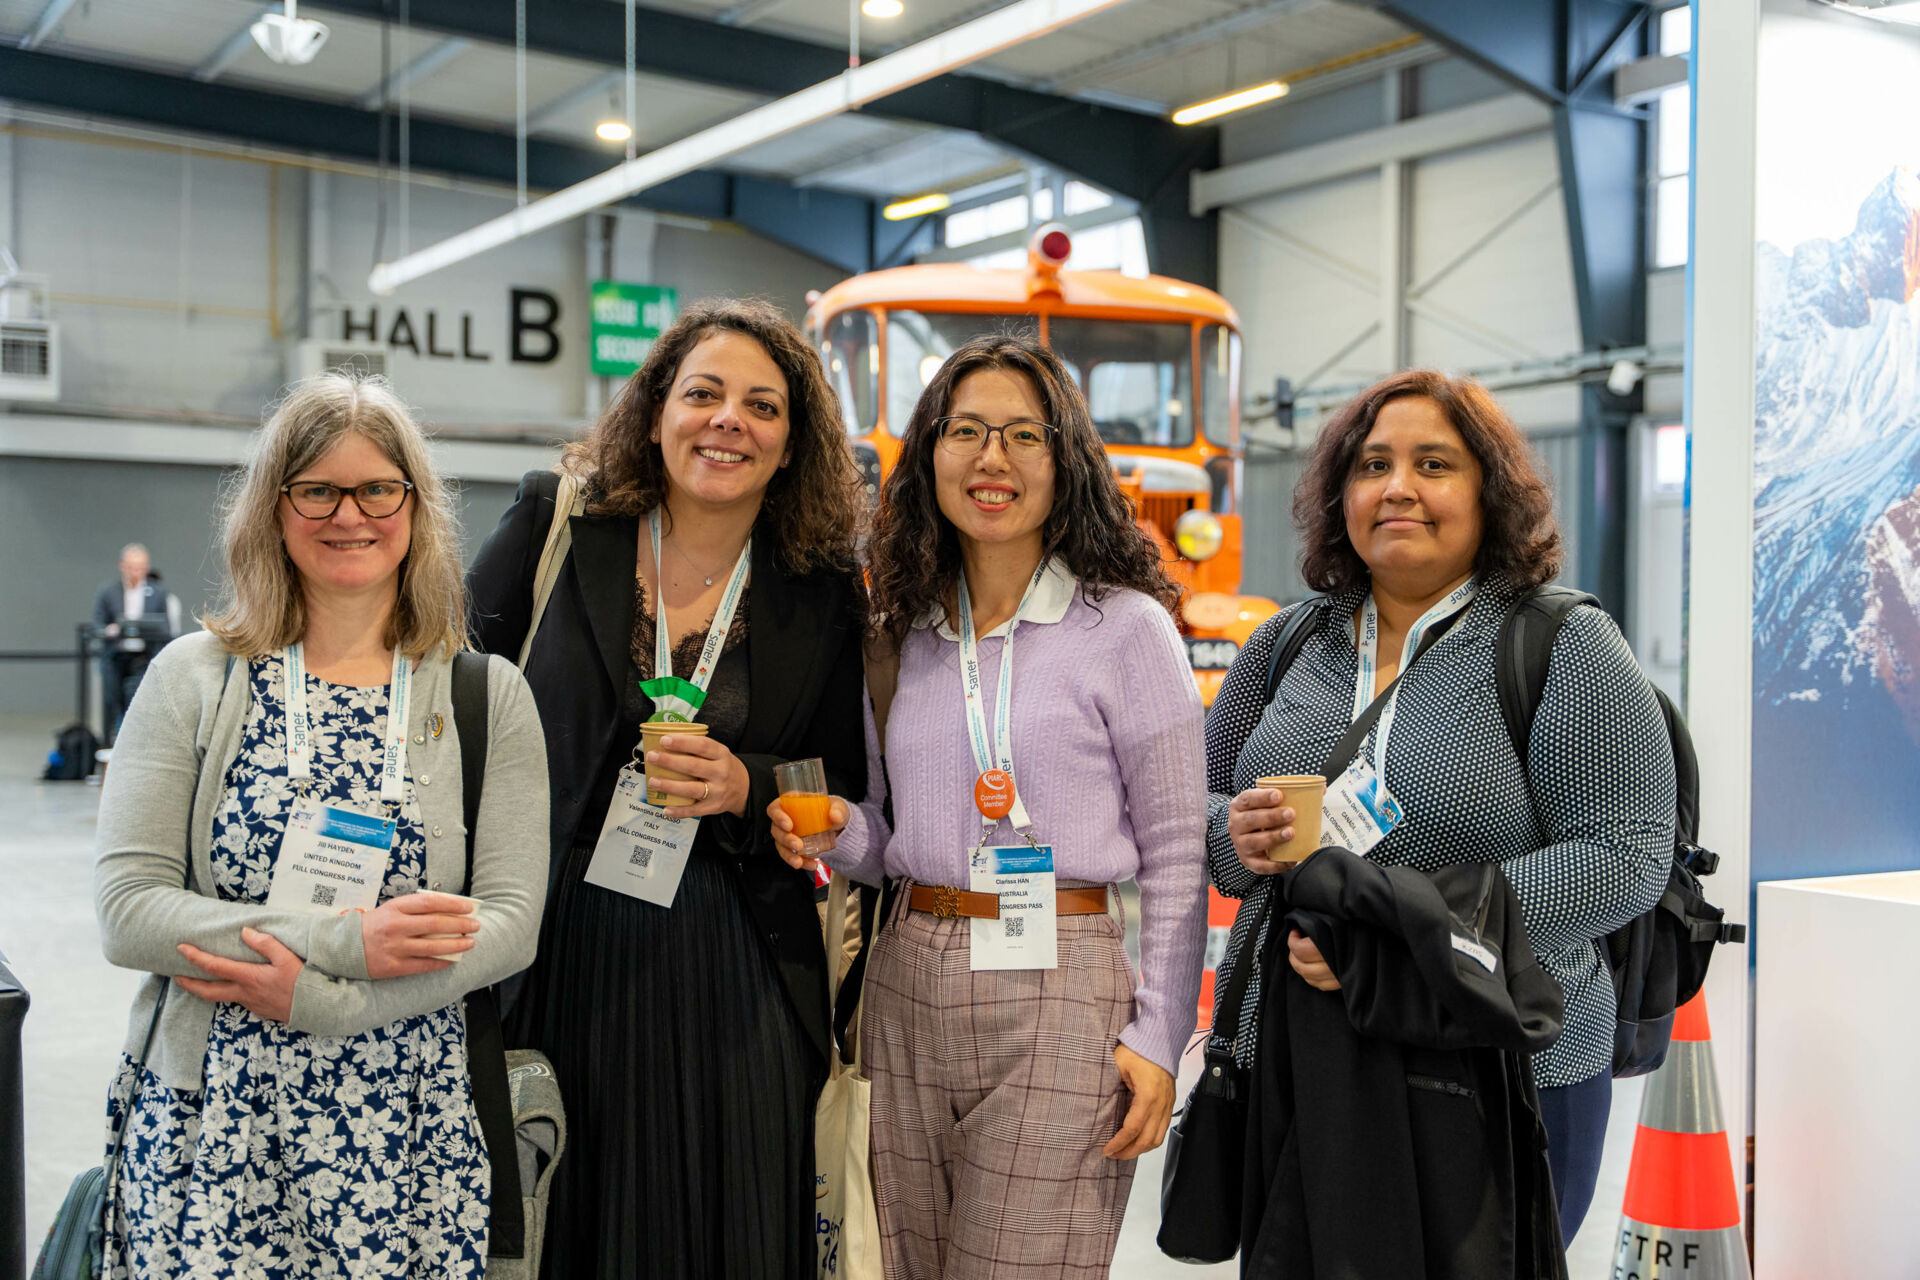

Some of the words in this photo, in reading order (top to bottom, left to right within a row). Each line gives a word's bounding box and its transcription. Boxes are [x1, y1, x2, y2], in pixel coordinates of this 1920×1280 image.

[343, 306, 491, 361] HALL
[510, 288, 561, 363] B
[1366, 612, 1376, 640] sanef
[702, 633, 718, 665] sanef
[967, 659, 979, 690] sanef
[293, 711, 305, 746] sanef
[385, 745, 398, 779] sanef
[629, 803, 654, 816] Valentina
[616, 825, 630, 835] FULL
[631, 830, 662, 845] CONGRESS
[662, 840, 677, 850] PASS
[643, 821, 660, 831] ITALY
[303, 852, 328, 863] UNITED
[329, 857, 362, 870] KINGDOM
[327, 843, 355, 855] HAYDEN
[292, 864, 308, 873] FULL
[309, 868, 346, 881] CONGRESS
[346, 876, 365, 885] PASS
